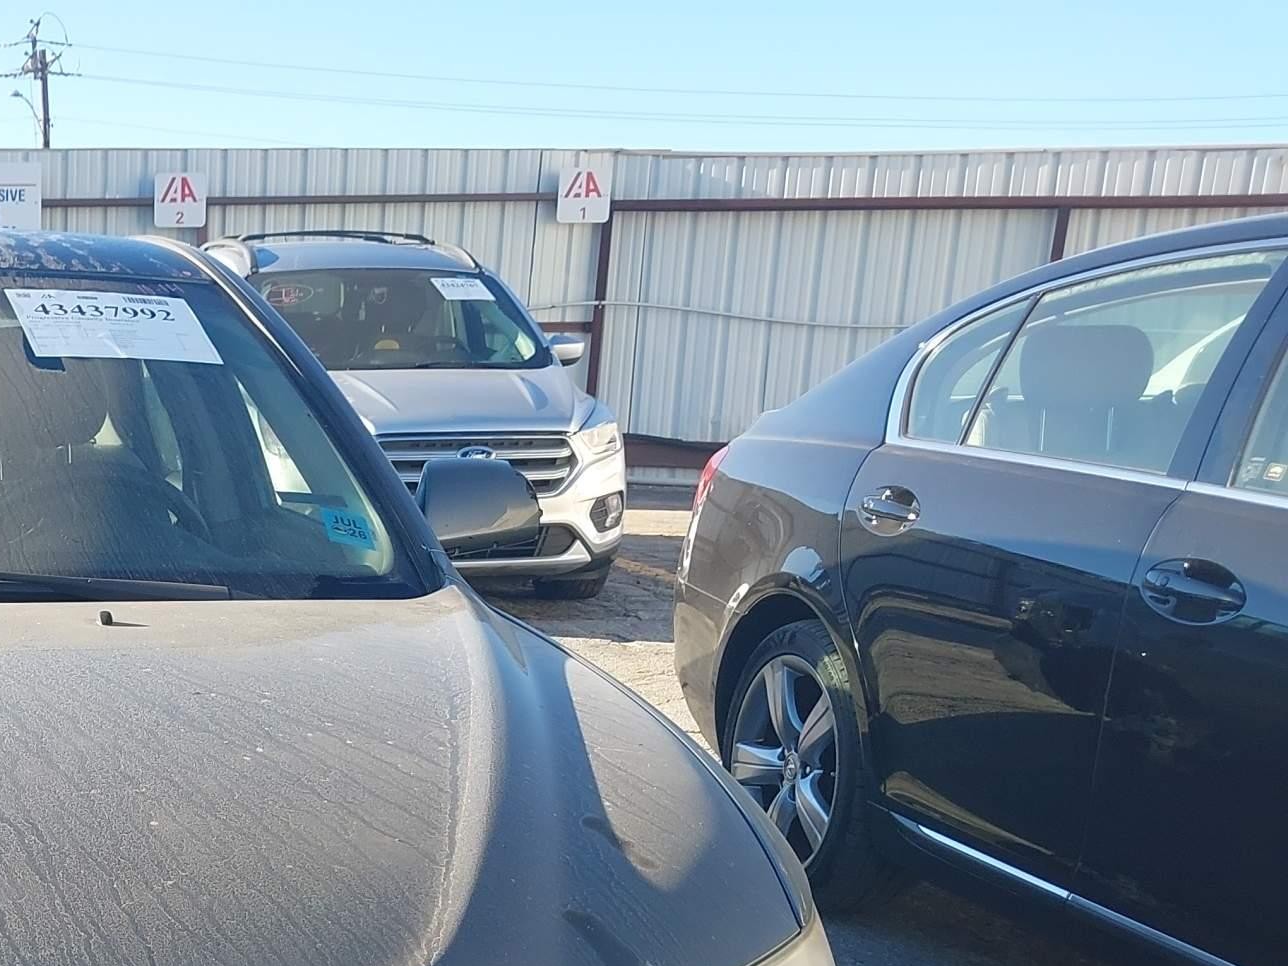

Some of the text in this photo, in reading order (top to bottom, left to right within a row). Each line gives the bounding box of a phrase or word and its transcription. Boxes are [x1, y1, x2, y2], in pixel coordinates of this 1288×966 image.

[175, 211, 184, 225] 2
[579, 206, 586, 220] 1
[34, 303, 175, 321] 43437992
[332, 515, 362, 530] JUL
